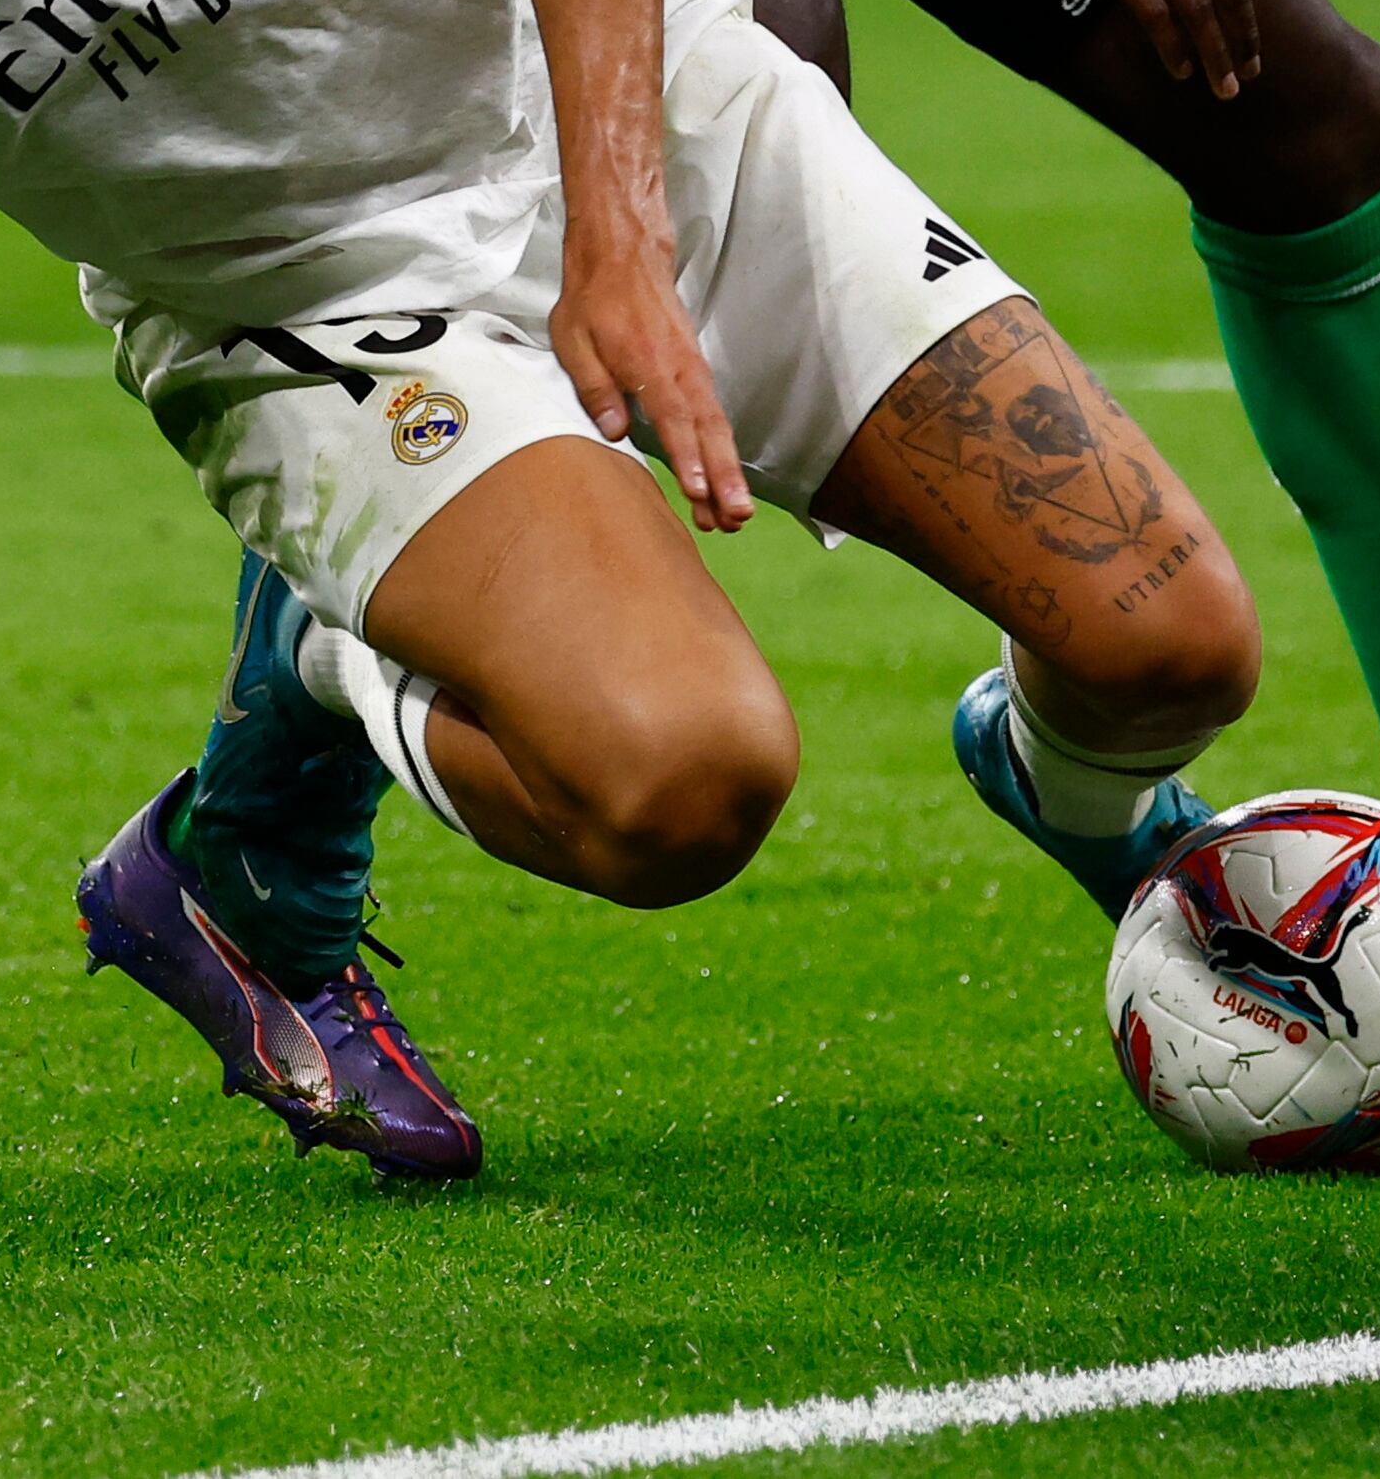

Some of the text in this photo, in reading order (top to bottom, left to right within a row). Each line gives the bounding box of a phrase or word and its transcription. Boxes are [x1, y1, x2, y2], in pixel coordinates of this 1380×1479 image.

[87, 0, 182, 102] FLY
[1114, 532, 1200, 613] UTRERA
[1213, 985, 1281, 1033] LALIGA
